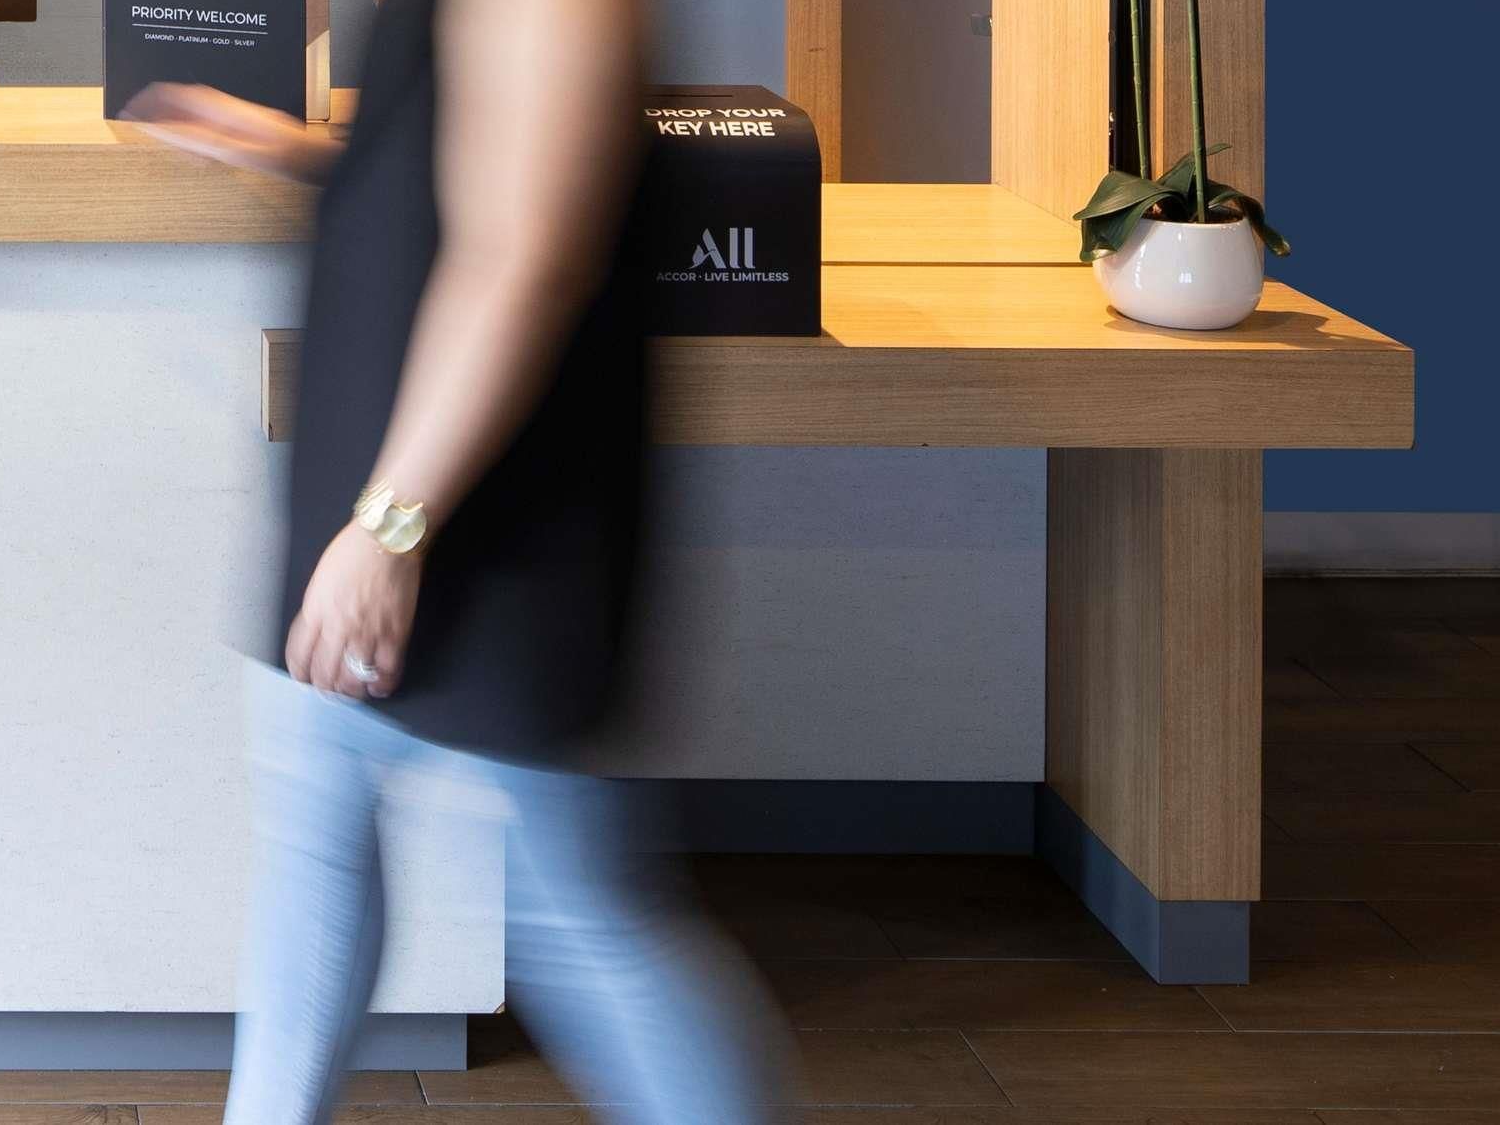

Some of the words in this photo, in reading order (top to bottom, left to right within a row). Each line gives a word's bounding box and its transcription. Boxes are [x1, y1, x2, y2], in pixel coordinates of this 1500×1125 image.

[131, 6, 194, 21] PRIORITY
[196, 10, 267, 26] WELCOME
[145, 33, 175, 42] DIAMOND
[178, 35, 209, 44] PLATINUM
[234, 39, 255, 47] SILVER
[644, 108, 713, 118] DROP
[716, 108, 787, 118] YOUR
[657, 120, 704, 136] KEY
[708, 121, 776, 137] HERE
[656, 271, 697, 282] ACCOR
[704, 272, 730, 282] LIVE
[732, 272, 789, 282] LIMITLESS
